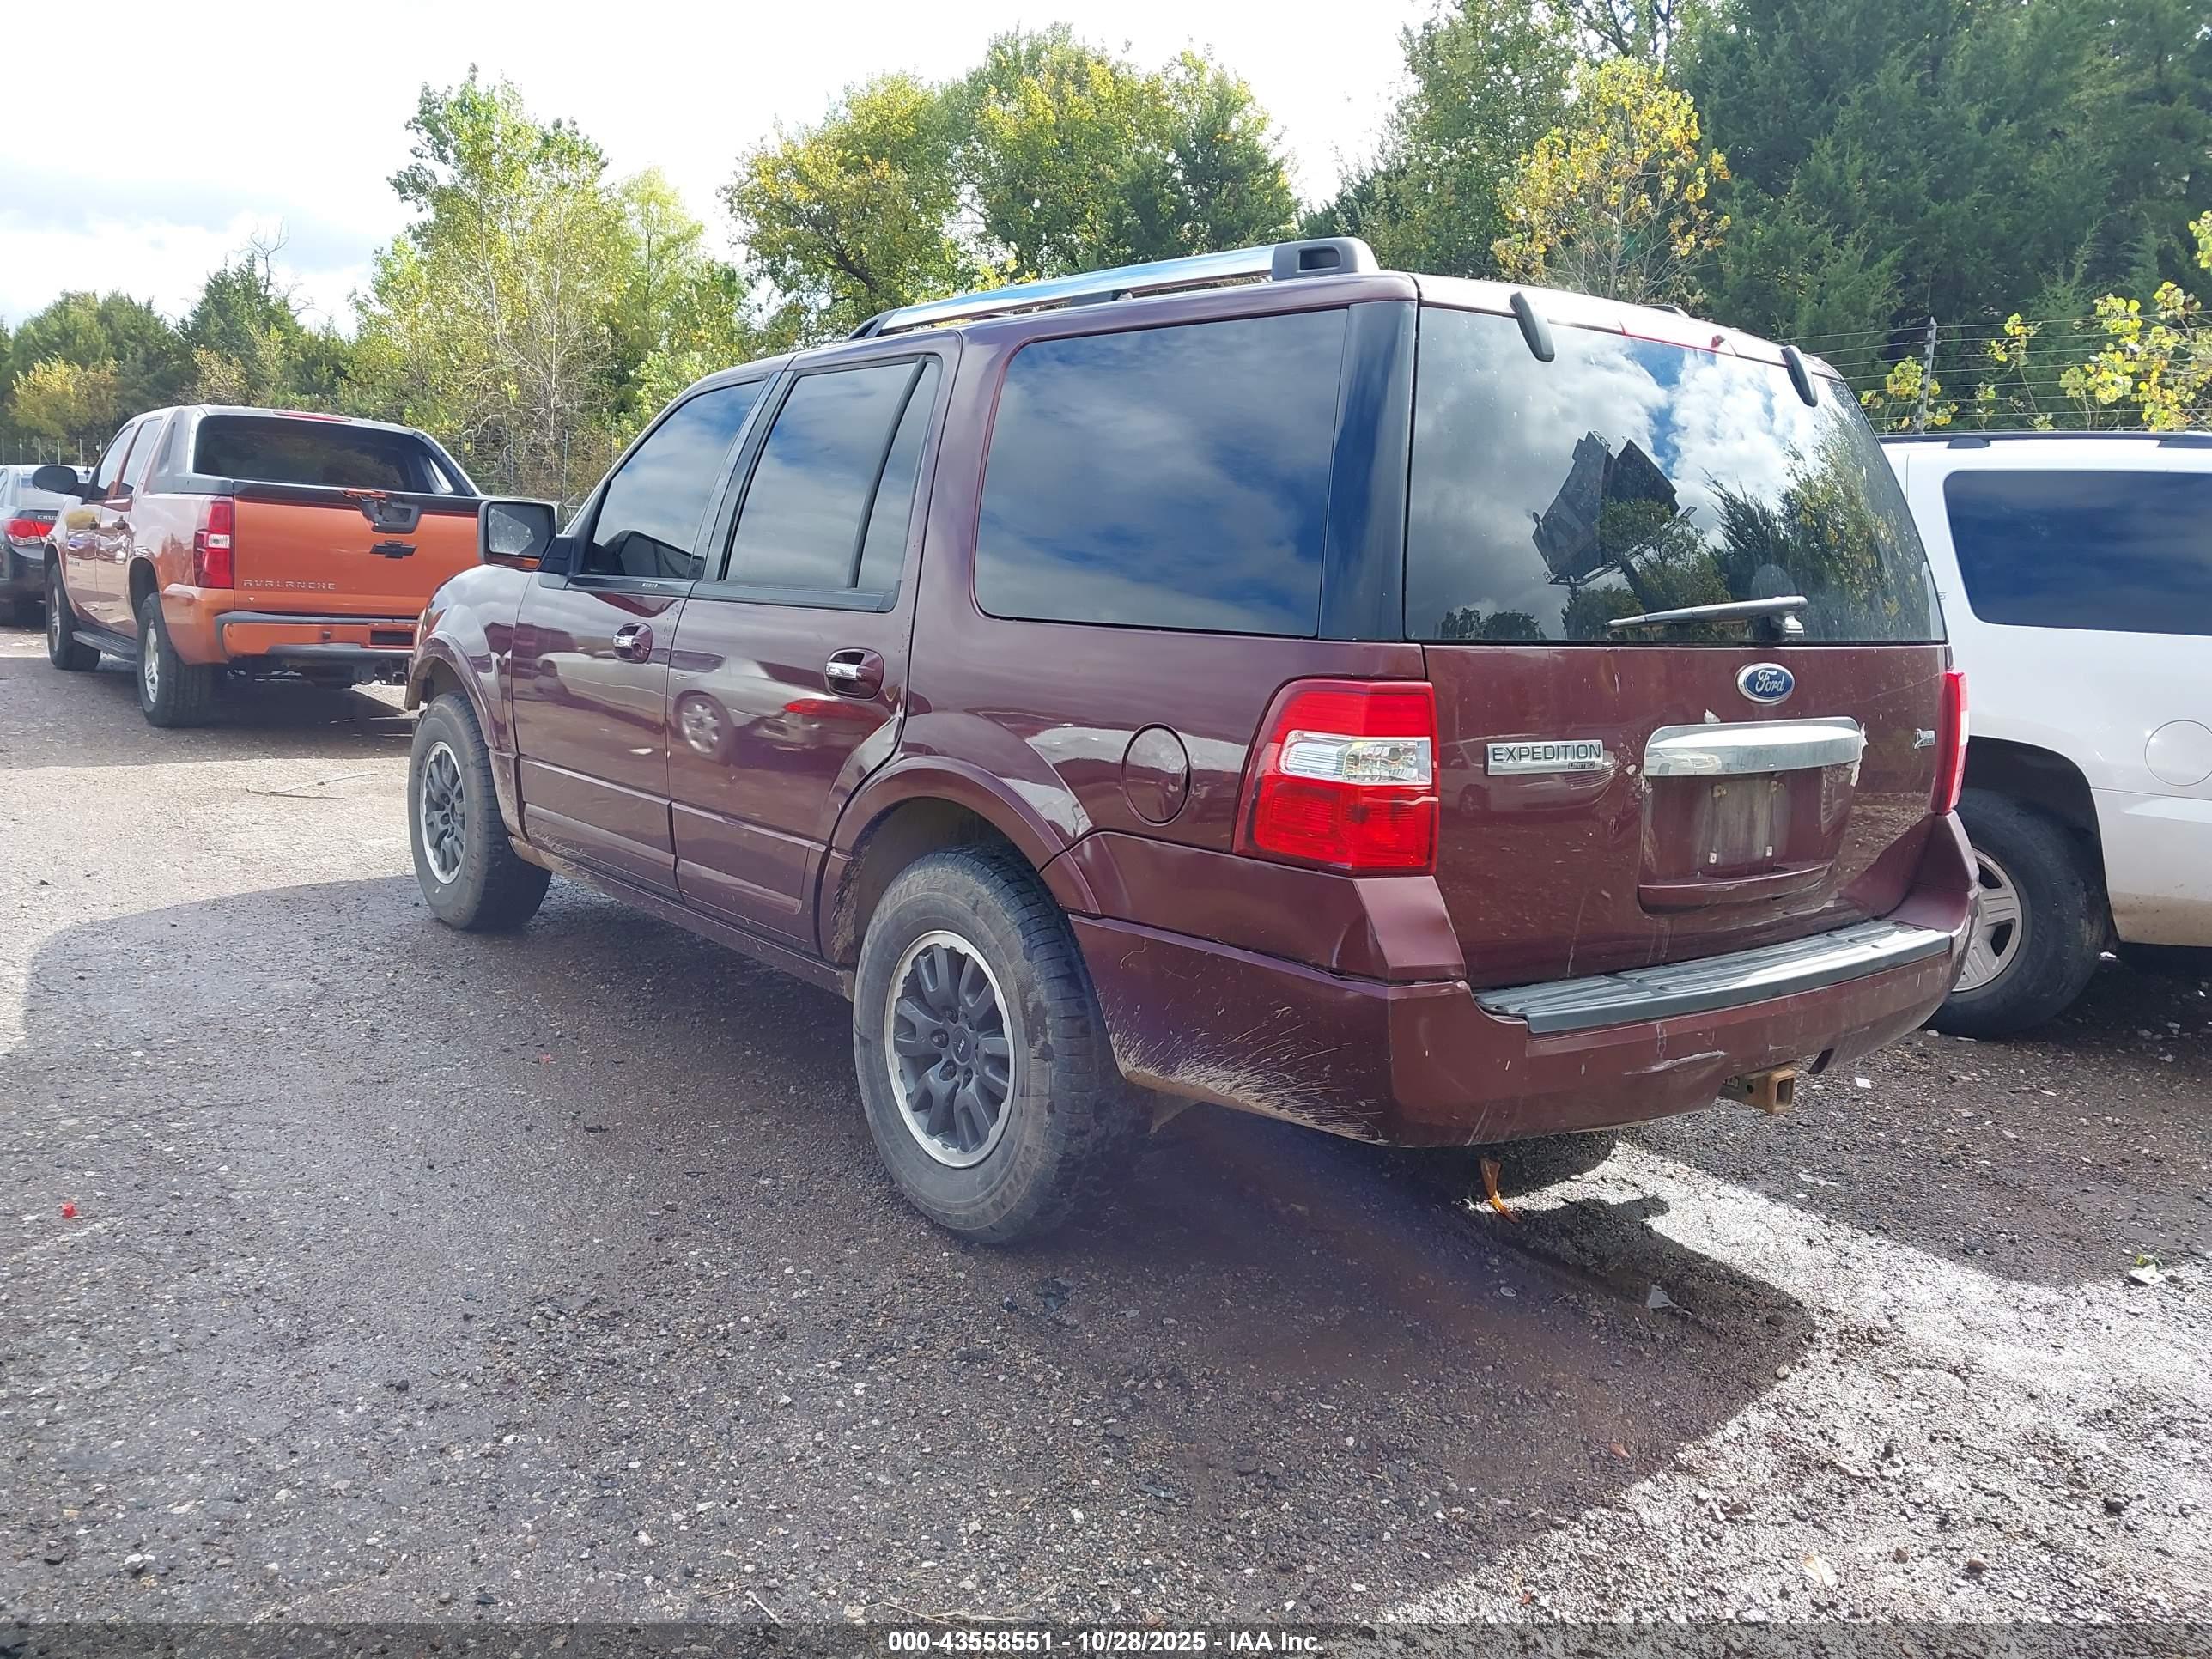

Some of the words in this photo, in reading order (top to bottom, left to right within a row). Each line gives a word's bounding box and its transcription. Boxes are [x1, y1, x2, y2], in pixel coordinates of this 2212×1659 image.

[243, 580, 337, 590] AVALANCHE
[1755, 670, 1785, 693] Ford
[1492, 744, 1601, 762] EXPEDITION
